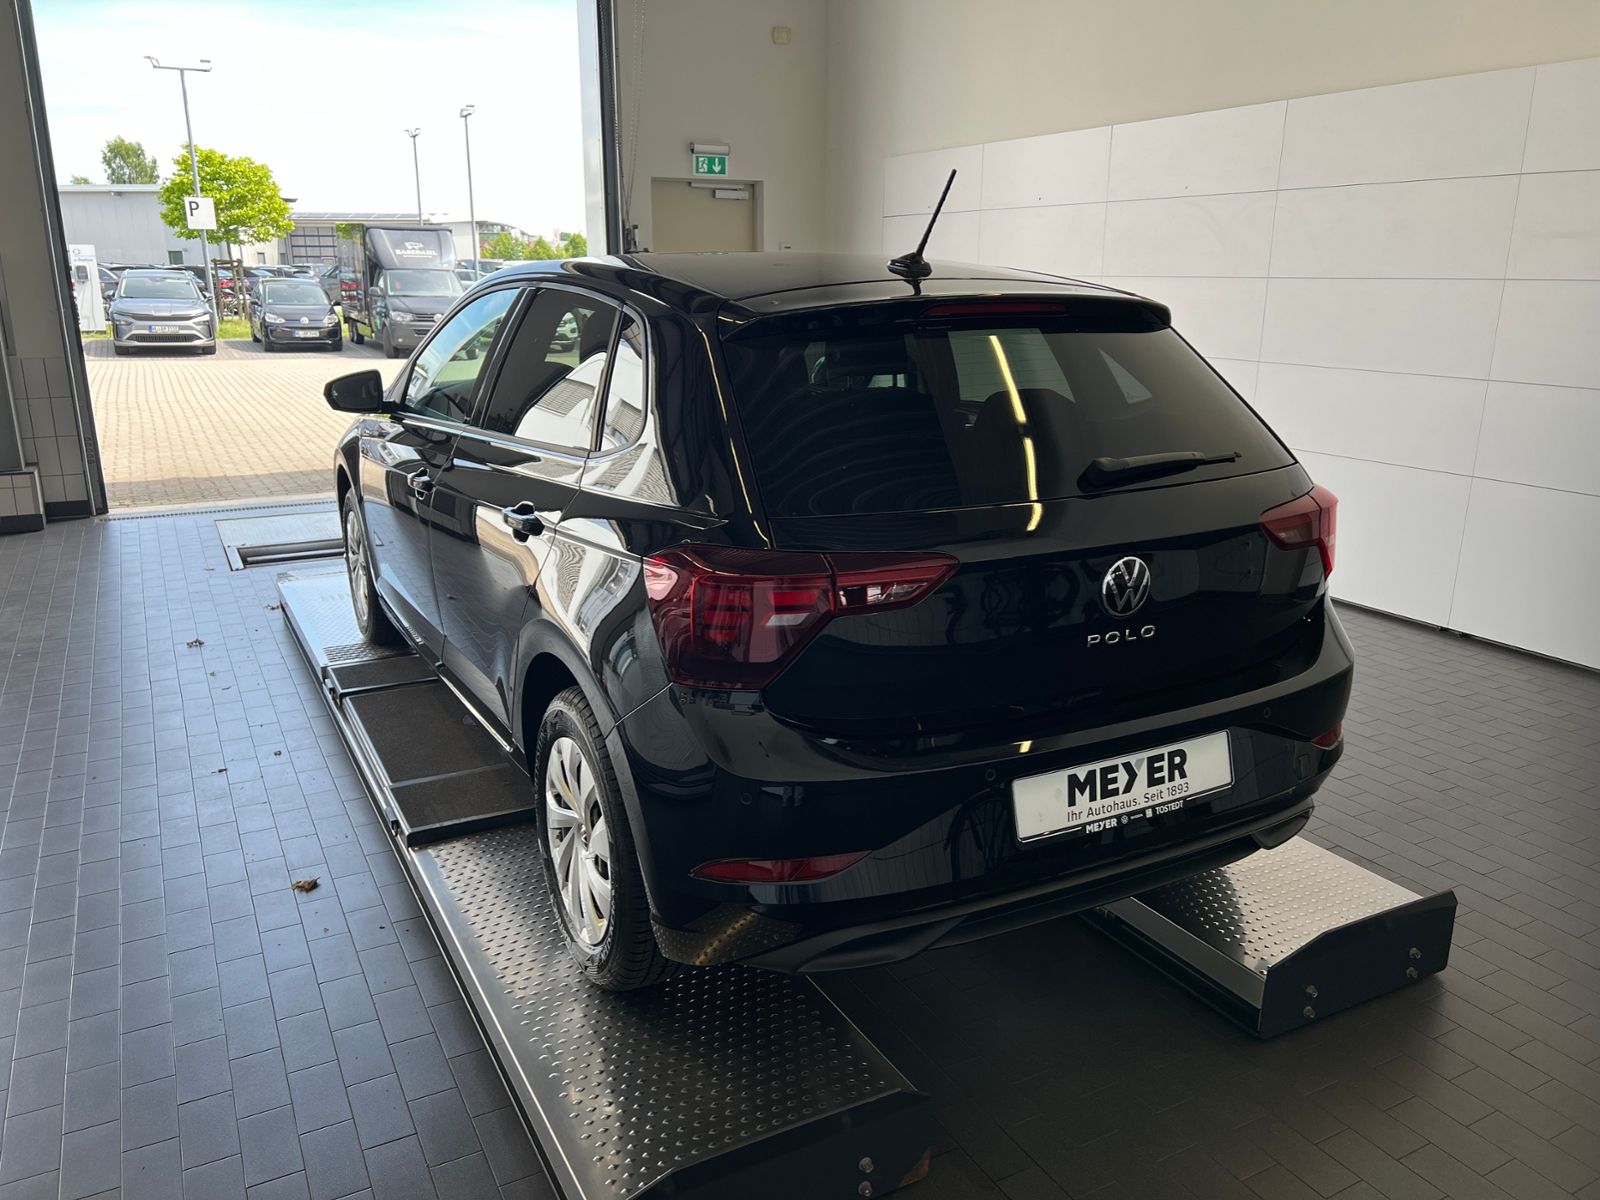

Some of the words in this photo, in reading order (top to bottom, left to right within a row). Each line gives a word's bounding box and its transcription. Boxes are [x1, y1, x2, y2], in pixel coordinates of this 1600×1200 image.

[188, 200, 200, 217] P
[1086, 624, 1156, 648] POLO
[1067, 748, 1188, 808] MEYER
[1067, 808, 1082, 823] Ihr
[1086, 796, 1141, 819] Autohaus.
[1144, 789, 1164, 803] Seit
[1167, 782, 1190, 798] 1893
[1086, 817, 1118, 834] MEYER
[1155, 800, 1184, 815] TOSTEDT
